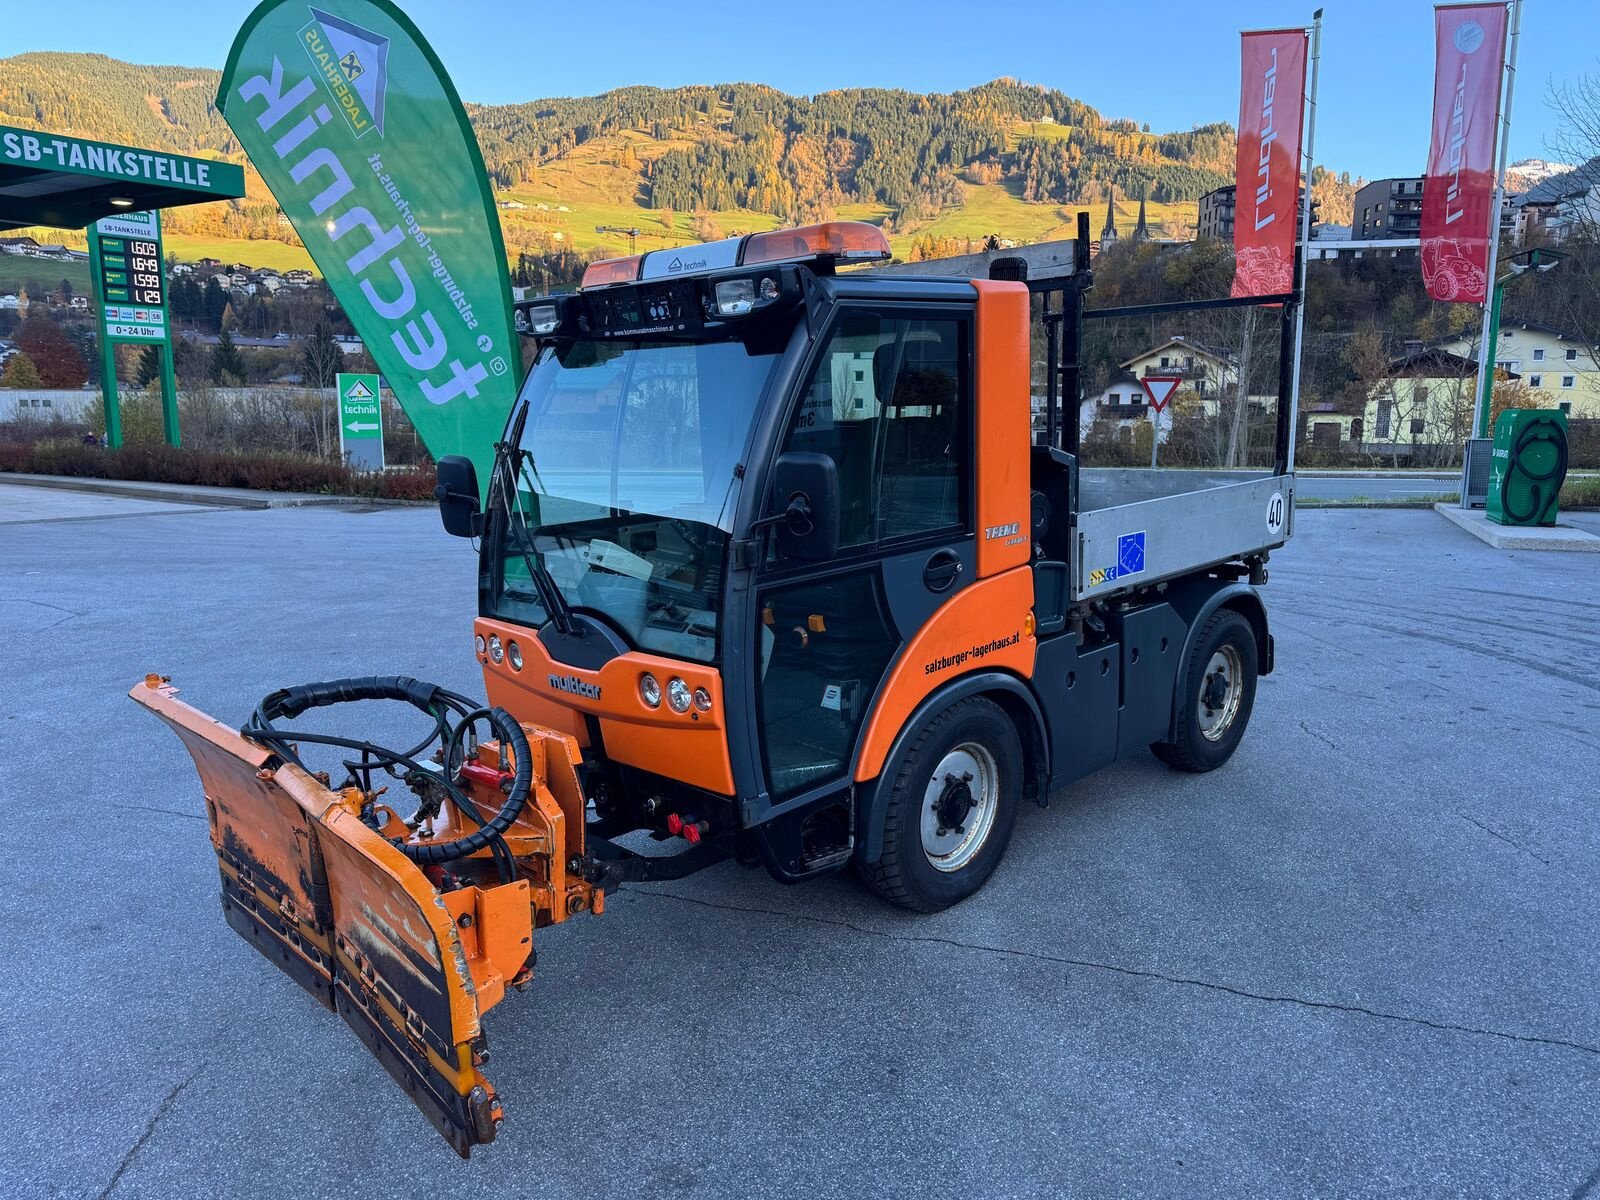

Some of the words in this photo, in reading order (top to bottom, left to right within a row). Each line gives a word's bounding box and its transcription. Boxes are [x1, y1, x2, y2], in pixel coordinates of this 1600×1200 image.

[3, 132, 211, 188] SB-TANKSTELLE
[103, 224, 152, 236] SB-TANKSTELLE
[683, 259, 707, 271] technik
[116, 326, 122, 334] 0
[128, 326, 139, 335] 24
[140, 327, 155, 336] Uhr
[344, 404, 377, 414] technik
[1268, 498, 1282, 528] 40
[985, 523, 1020, 540] TREMO
[925, 631, 1020, 675] salzburger-lagerhaus.at
[548, 674, 602, 700] multicar
